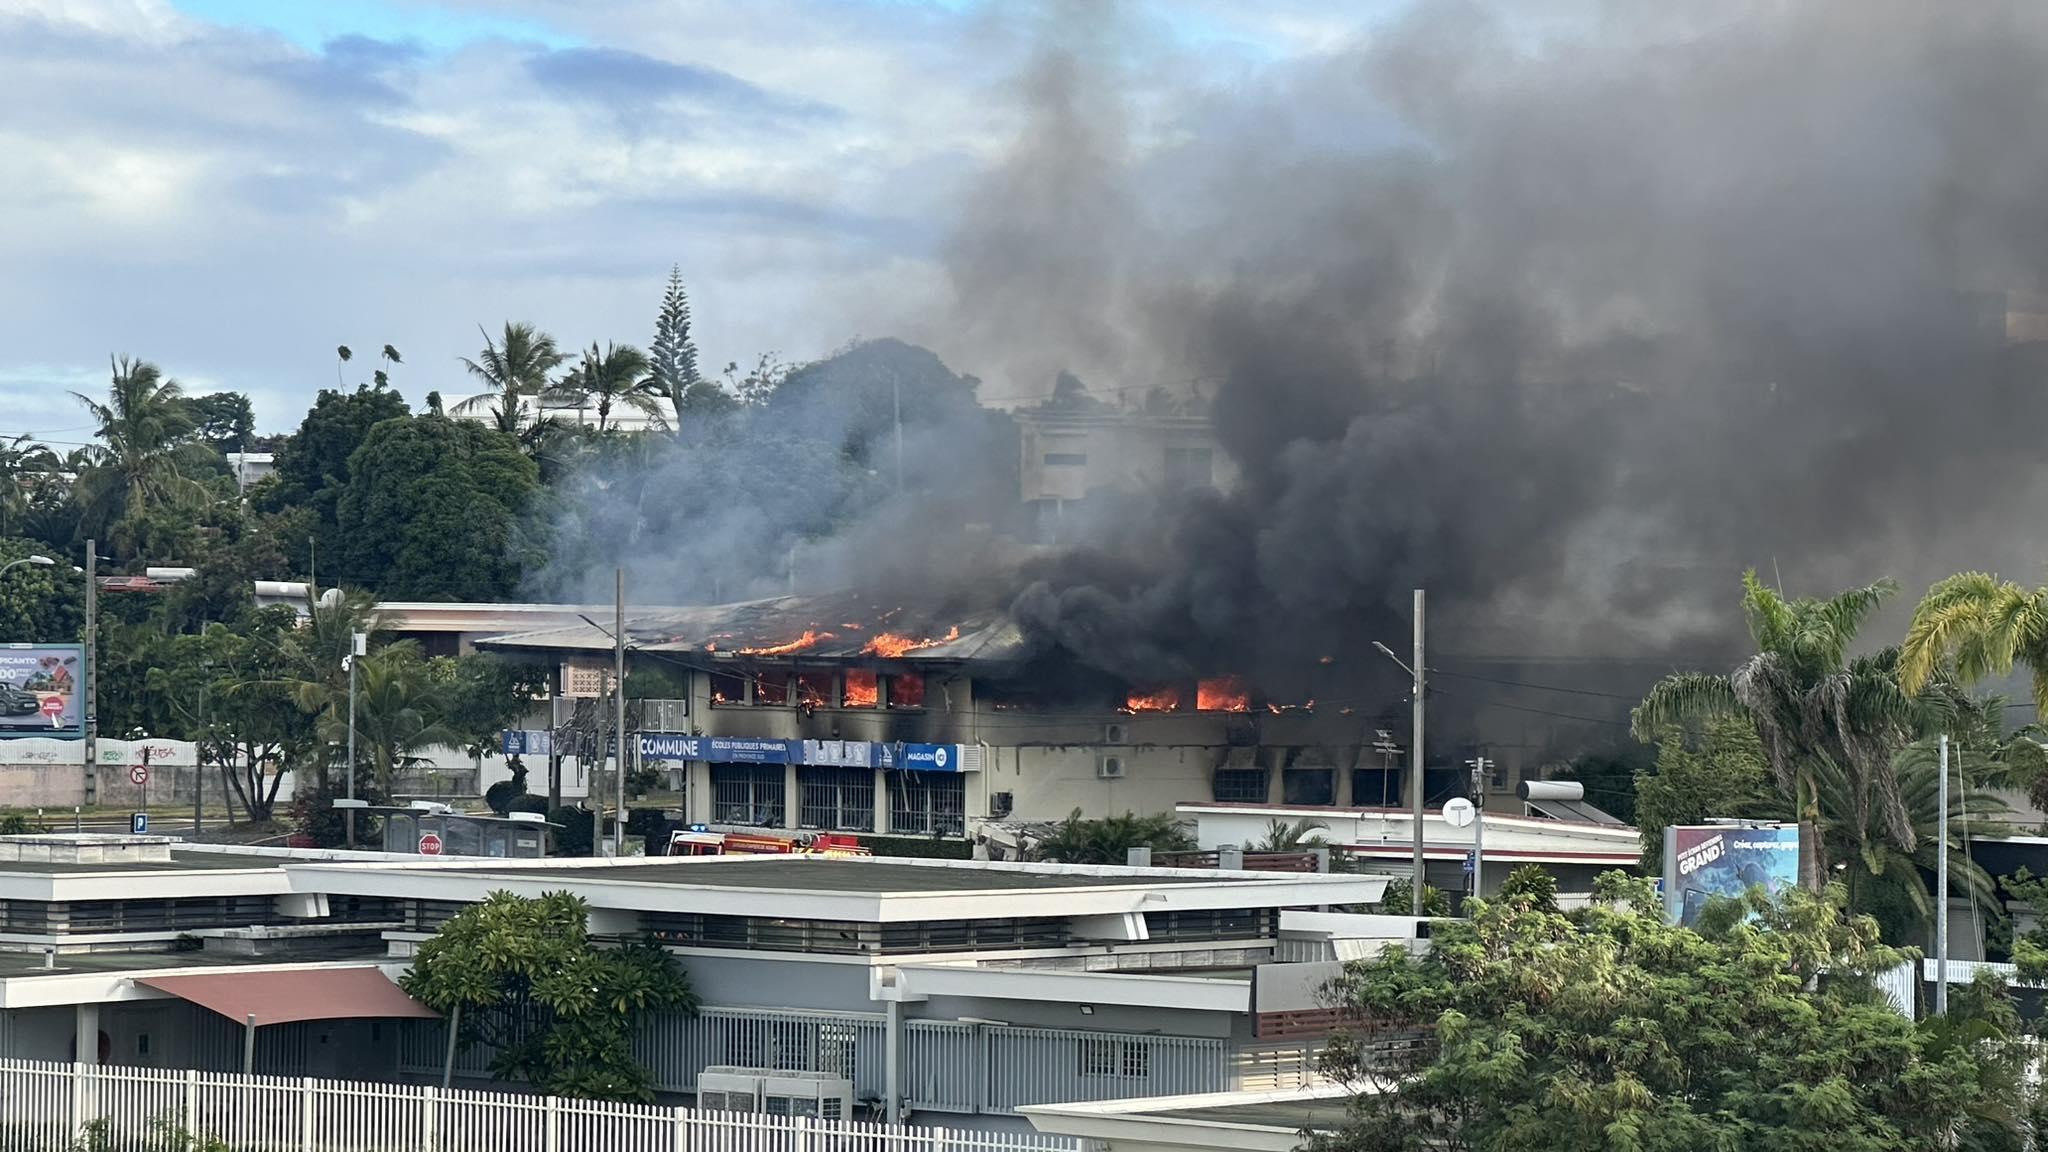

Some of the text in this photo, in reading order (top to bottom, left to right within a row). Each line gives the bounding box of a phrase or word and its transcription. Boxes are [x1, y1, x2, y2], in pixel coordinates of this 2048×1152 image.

[640, 738, 698, 756] COMMUNE
[711, 739, 787, 751] ÉCOLES PUBLIQUES PRIMAIRES
[907, 752, 935, 761] MAGASIN
[137, 817, 143, 829] P
[421, 843, 440, 851] STOP
